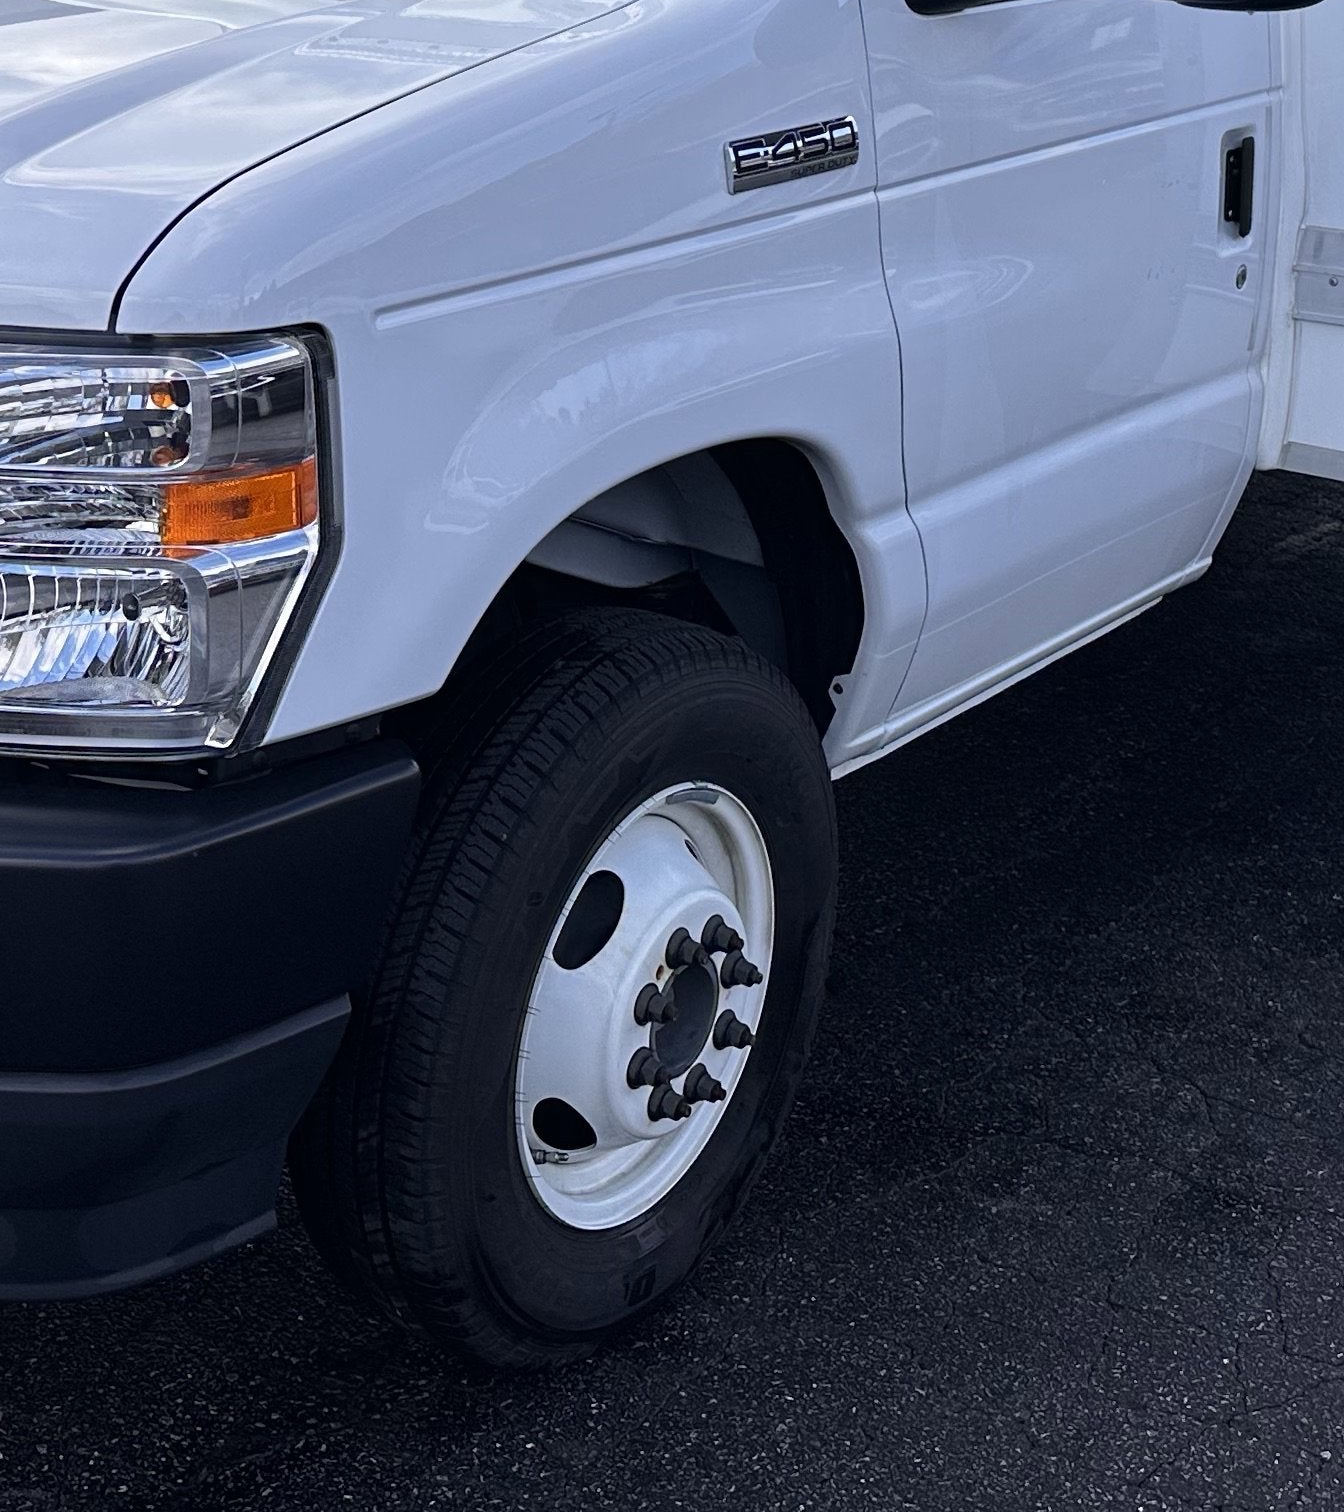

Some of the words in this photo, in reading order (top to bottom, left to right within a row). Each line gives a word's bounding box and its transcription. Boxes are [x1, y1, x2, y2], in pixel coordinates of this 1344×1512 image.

[729, 117, 858, 176] E-450
[790, 163, 825, 178] SUPER
[827, 155, 856, 169] DUTY
